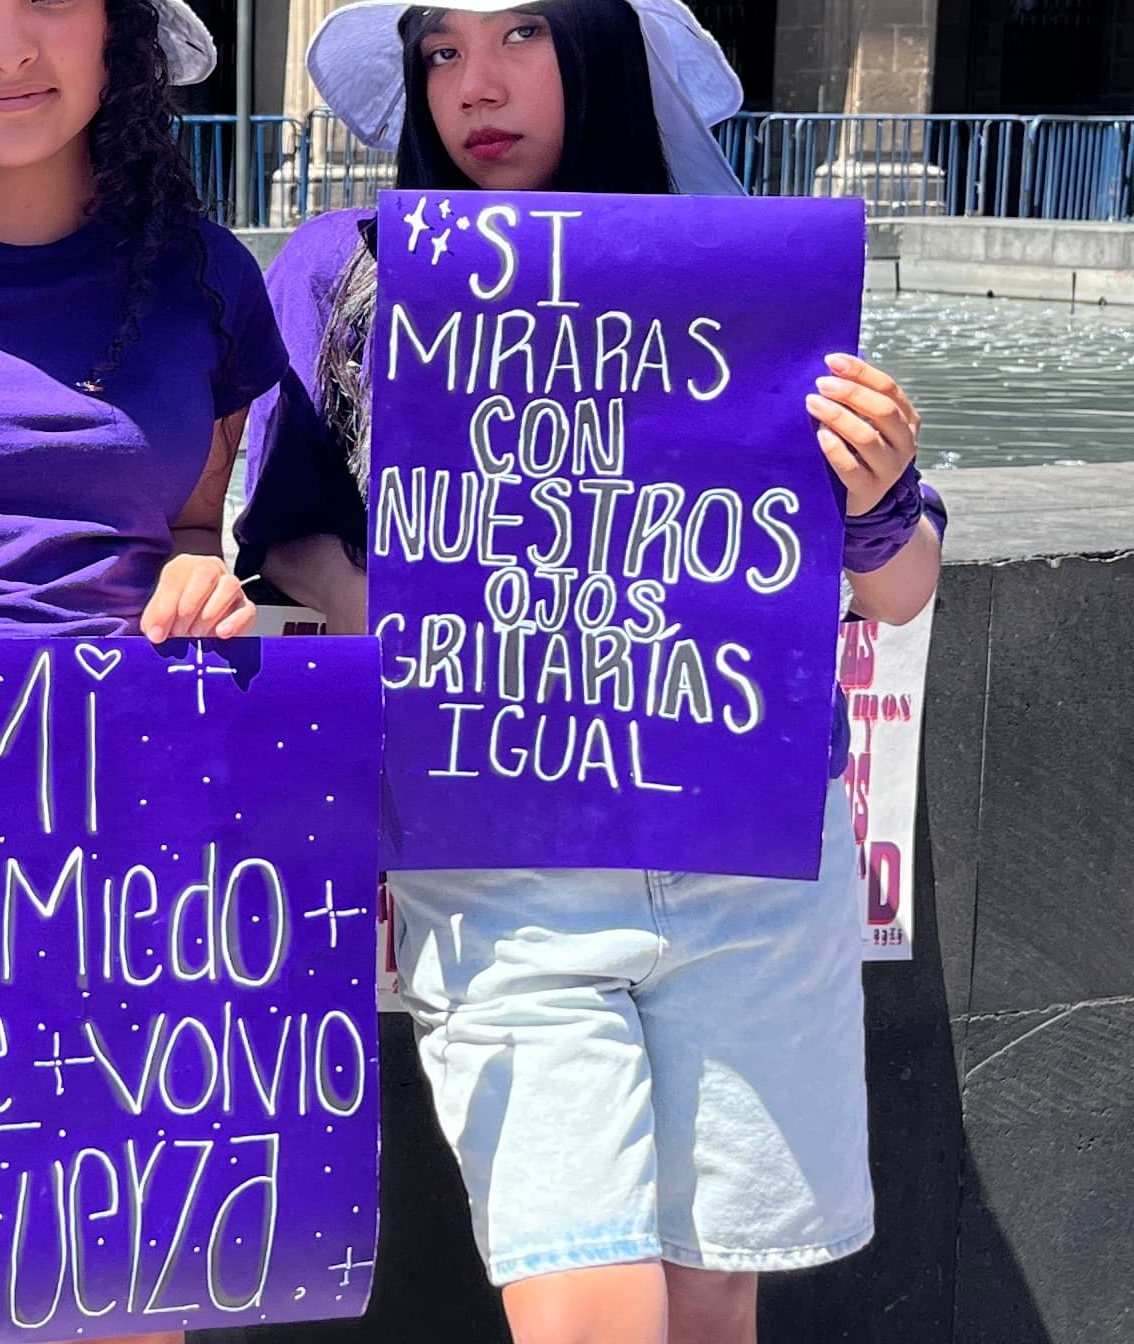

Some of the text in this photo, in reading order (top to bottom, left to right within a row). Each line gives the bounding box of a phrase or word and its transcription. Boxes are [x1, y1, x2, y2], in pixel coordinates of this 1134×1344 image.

[469, 205, 583, 308] SI
[387, 303, 731, 401] MIRARAS
[469, 394, 625, 479] CON
[374, 465, 802, 594] NUESTROS
[484, 566, 668, 643] OJOS
[428, 702, 683, 792] IGUAL
